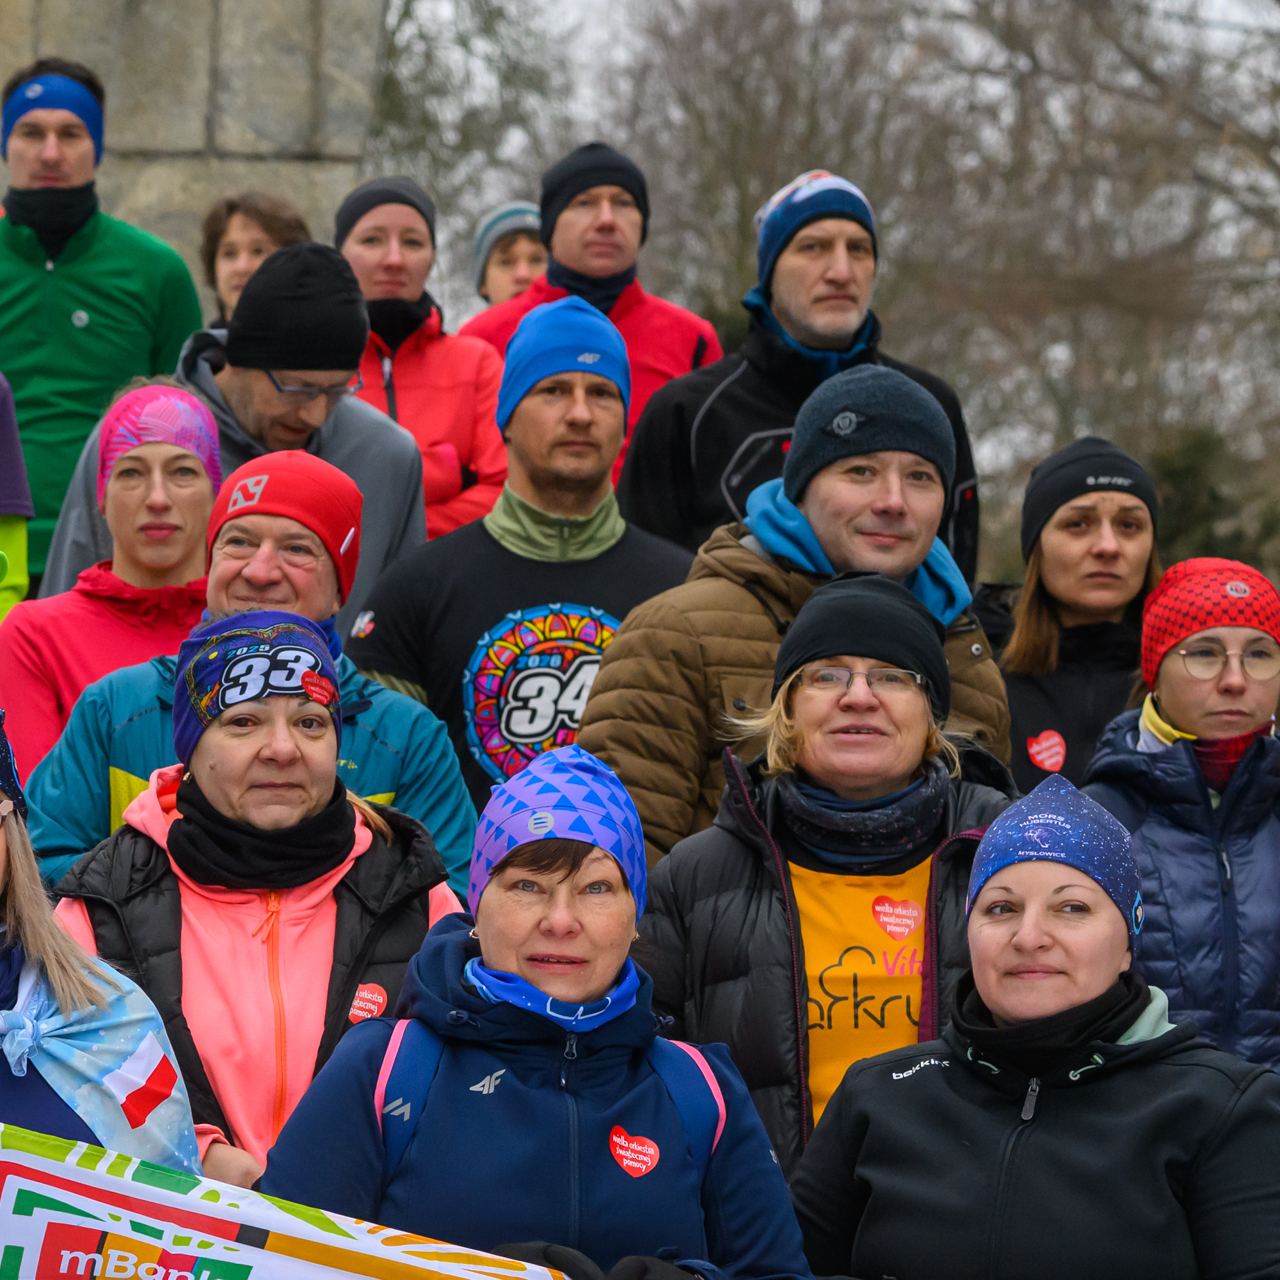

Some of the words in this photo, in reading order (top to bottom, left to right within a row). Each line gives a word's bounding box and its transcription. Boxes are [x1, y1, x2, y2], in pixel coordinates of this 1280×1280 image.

[226, 645, 270, 660] 2025
[516, 655, 562, 668] 2026
[221, 647, 319, 707] 33
[505, 658, 602, 740] 34
[1019, 818, 1072, 830] HUBERTUS
[1028, 813, 1066, 822] MORS
[469, 1068, 507, 1095] 4F
